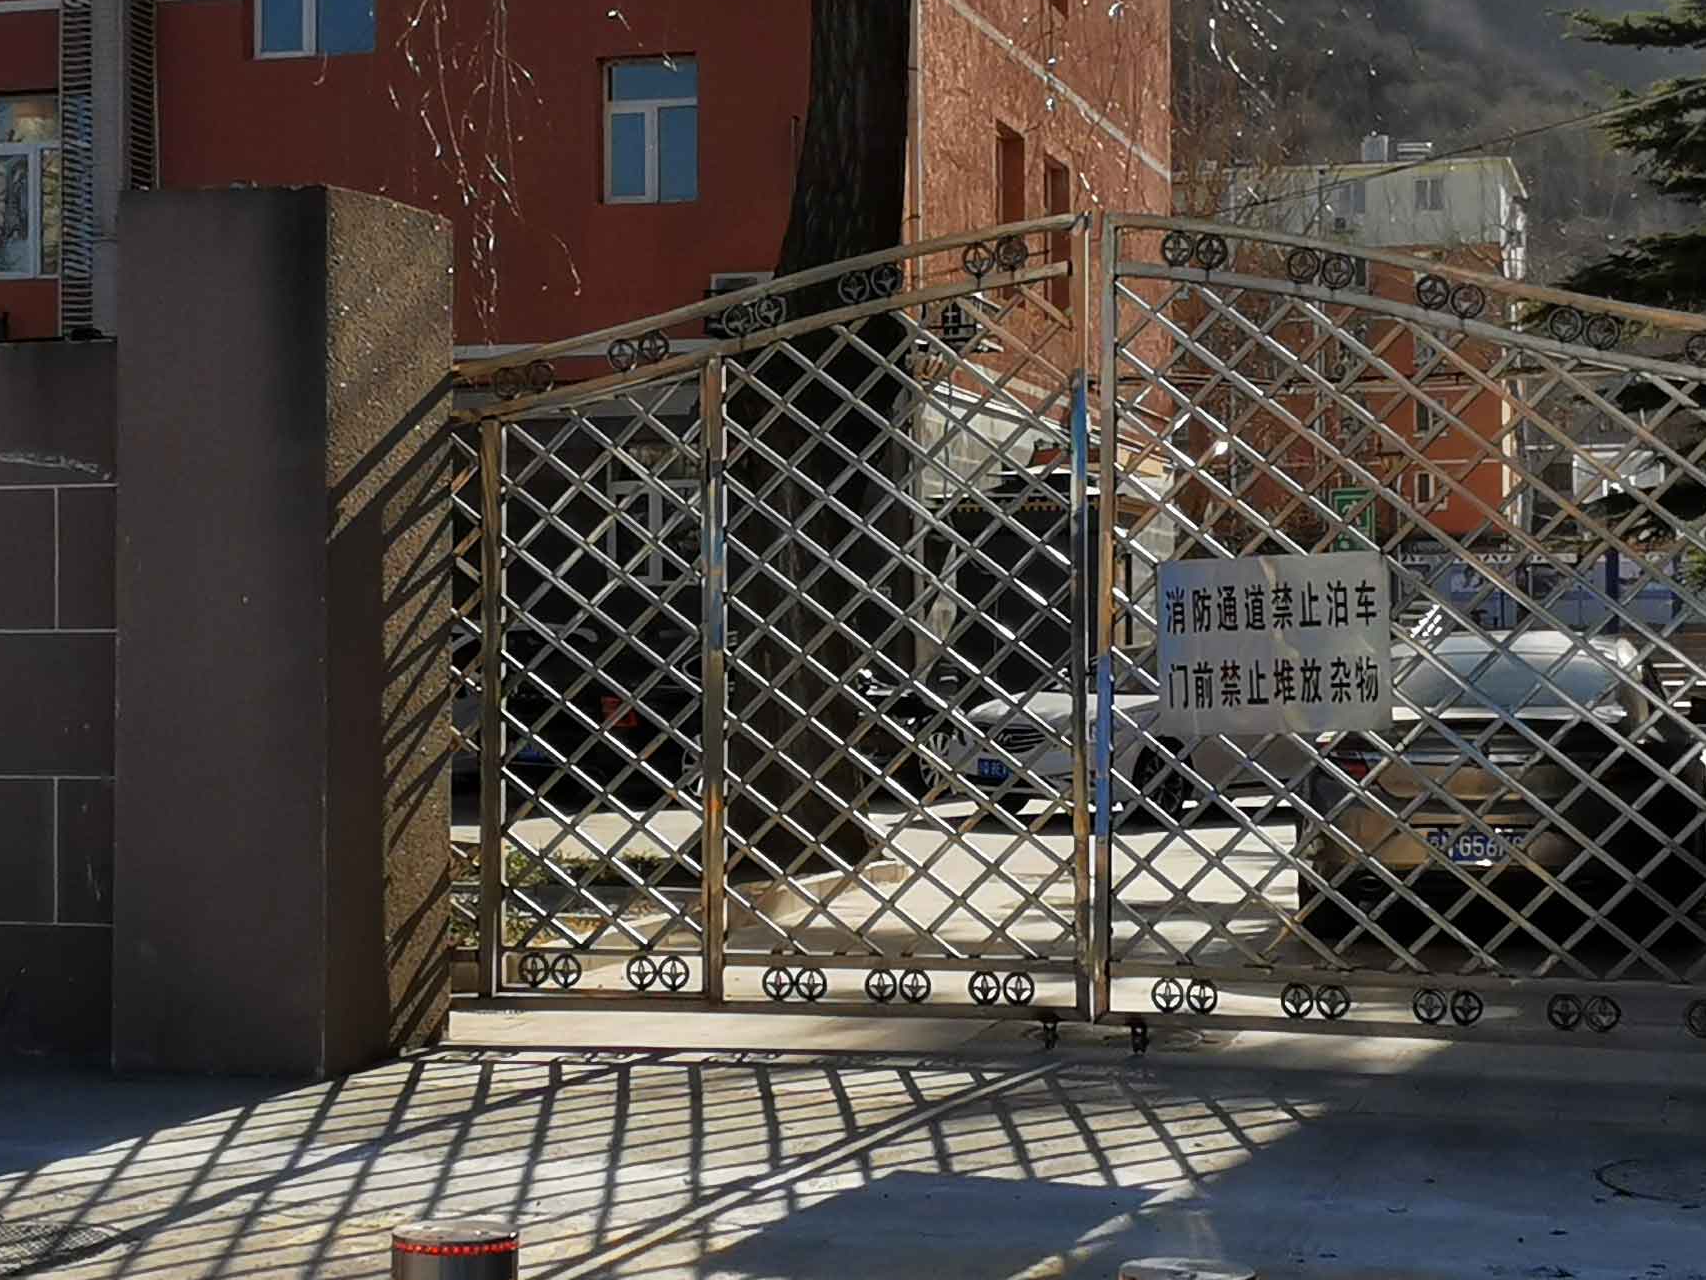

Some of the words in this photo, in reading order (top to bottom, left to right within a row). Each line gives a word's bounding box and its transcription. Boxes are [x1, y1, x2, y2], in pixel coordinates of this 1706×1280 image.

[1165, 580, 1377, 634] 消防通道禁止泊车
[1168, 656, 1379, 709] 门前禁止堆放杂物
